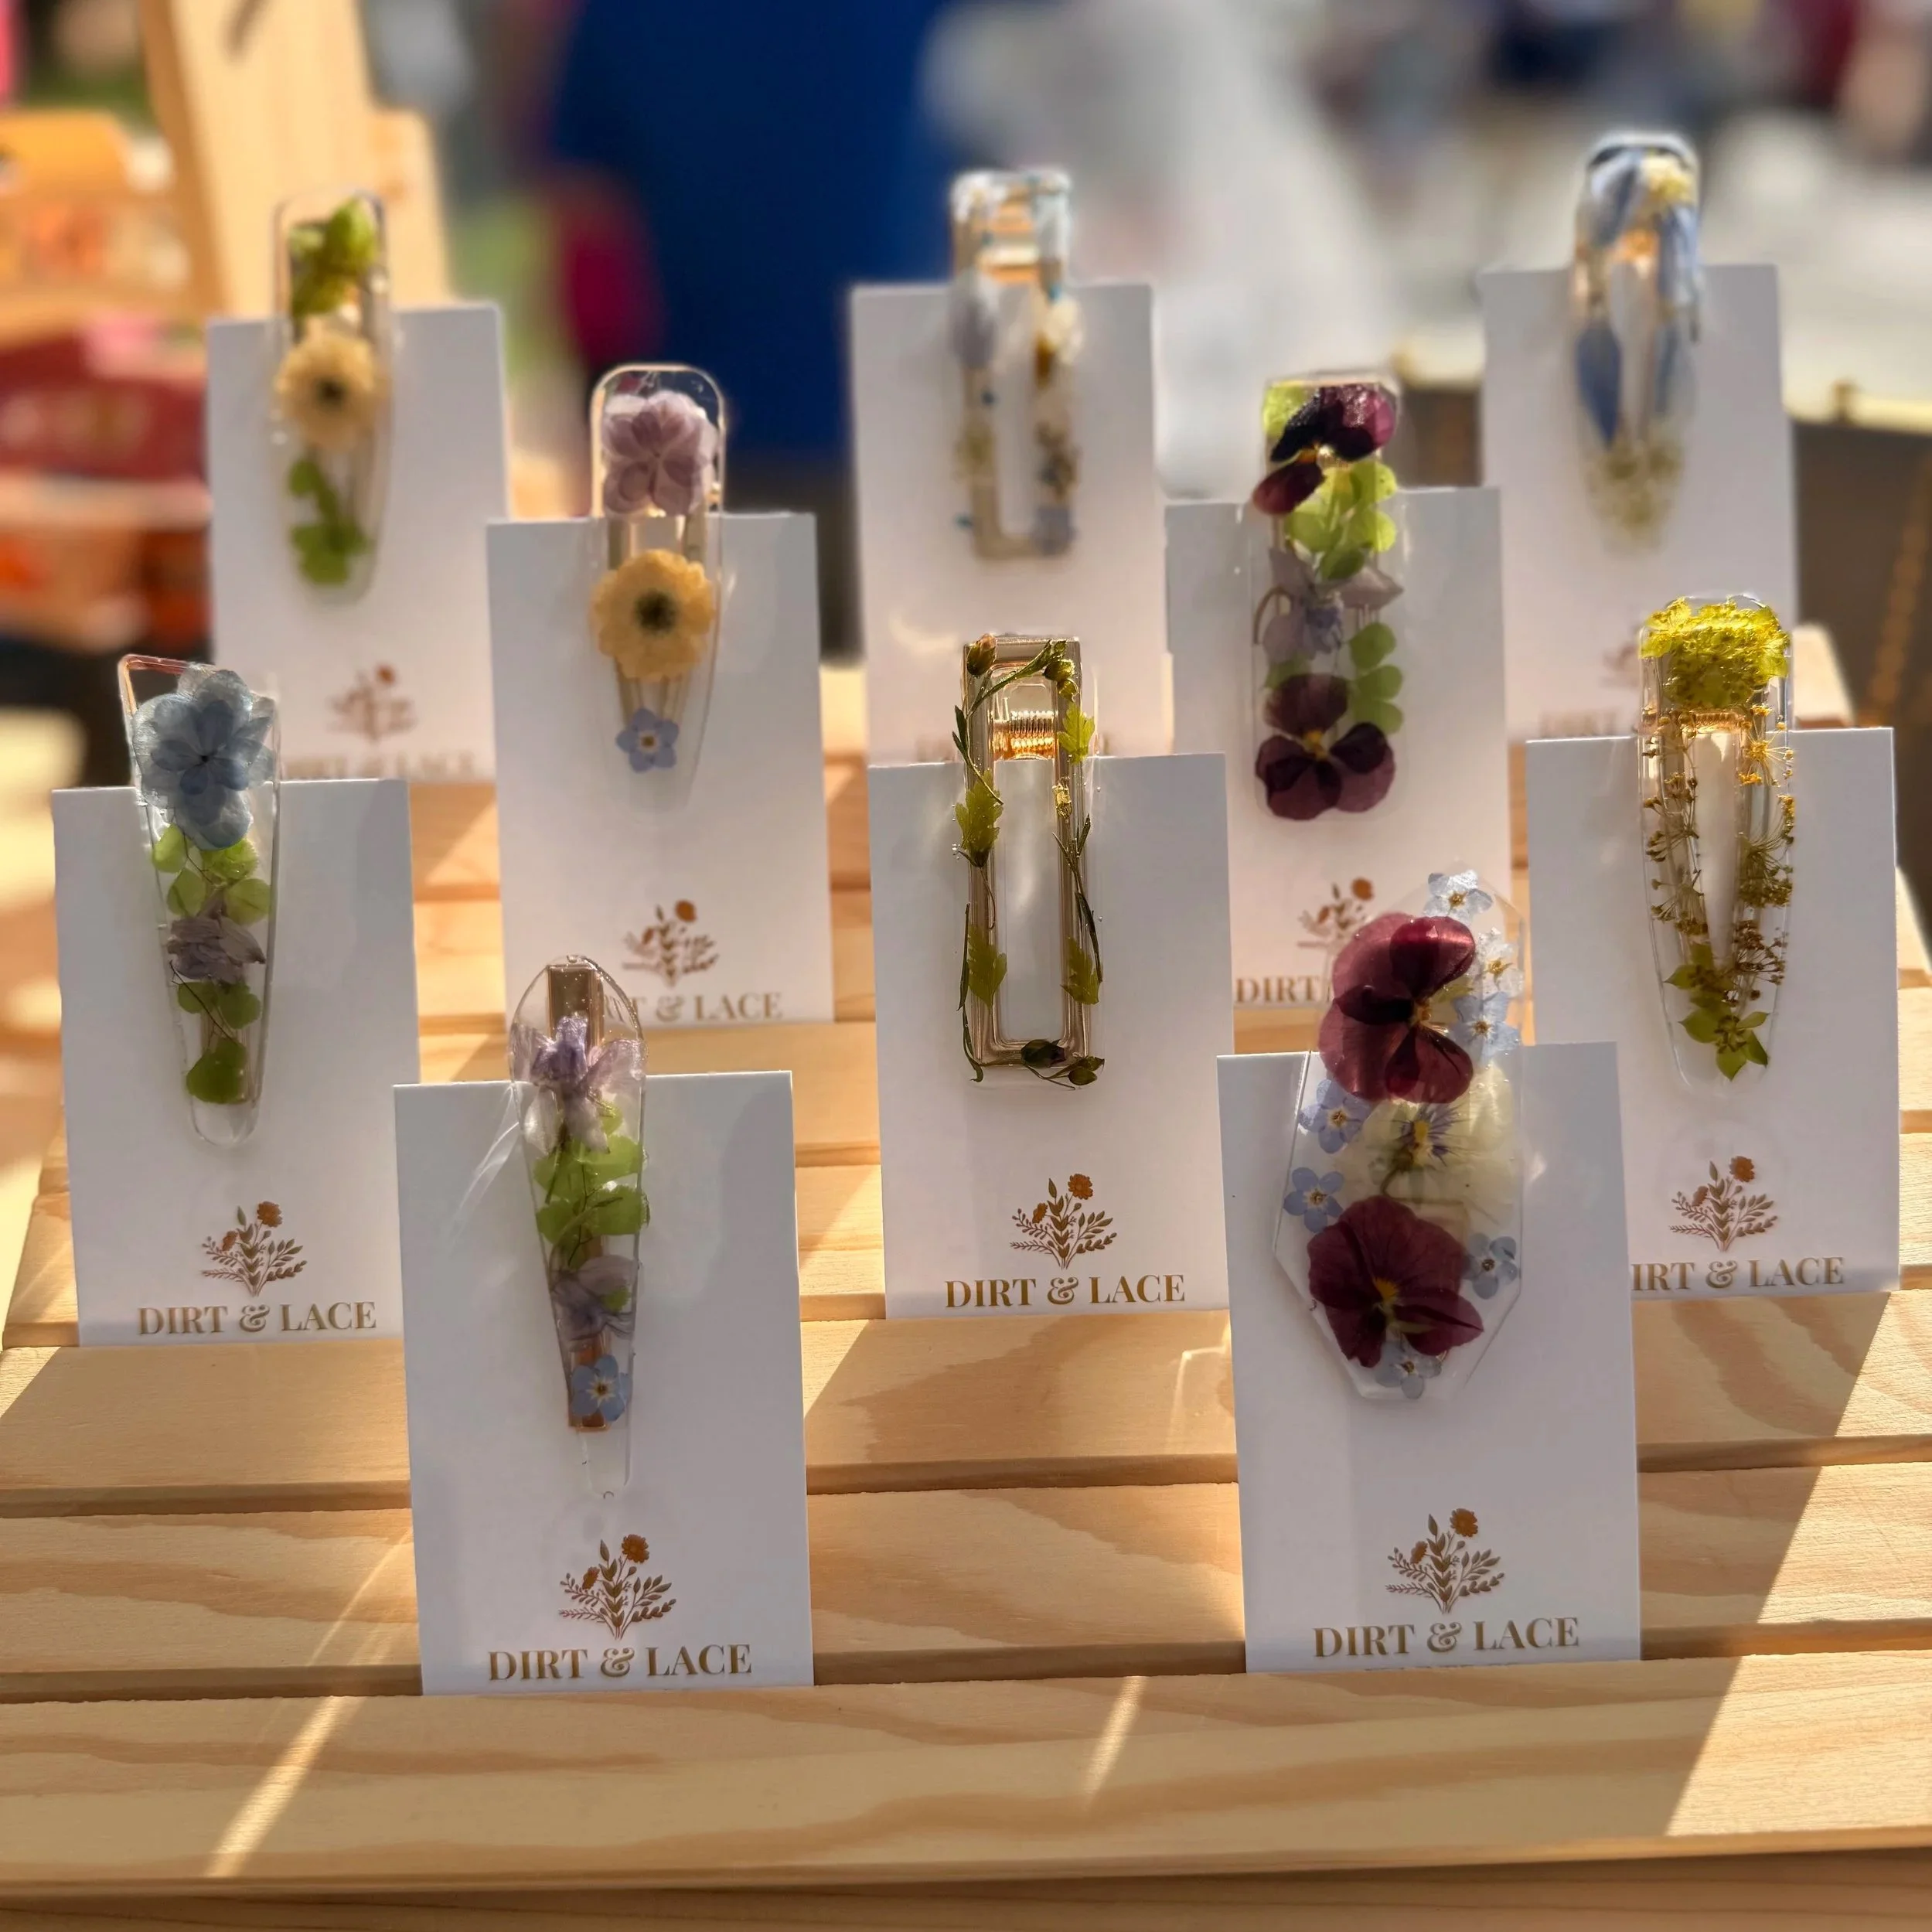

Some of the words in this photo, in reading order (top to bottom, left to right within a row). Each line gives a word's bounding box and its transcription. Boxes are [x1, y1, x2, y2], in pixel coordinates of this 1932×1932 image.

[656, 994, 684, 1021] &
[693, 992, 783, 1021] LACE
[1236, 976, 1320, 1003] DIRT
[1630, 1262, 1695, 1290] IRT
[1705, 1260, 1737, 1288] &
[1748, 1256, 1844, 1287] LACE
[945, 1279, 1037, 1307] DIRT
[1047, 1277, 1078, 1305] &
[1089, 1274, 1185, 1303] LACE
[137, 1306, 228, 1335] DIRT
[239, 1304, 271, 1332] &
[279, 1301, 377, 1331] LACE
[1313, 1624, 1415, 1657] DIRT
[1426, 1622, 1462, 1652] &
[1472, 1617, 1579, 1651] LACE
[488, 1648, 588, 1681] DIRT
[600, 1647, 635, 1678] &
[645, 1644, 752, 1676] LACE
